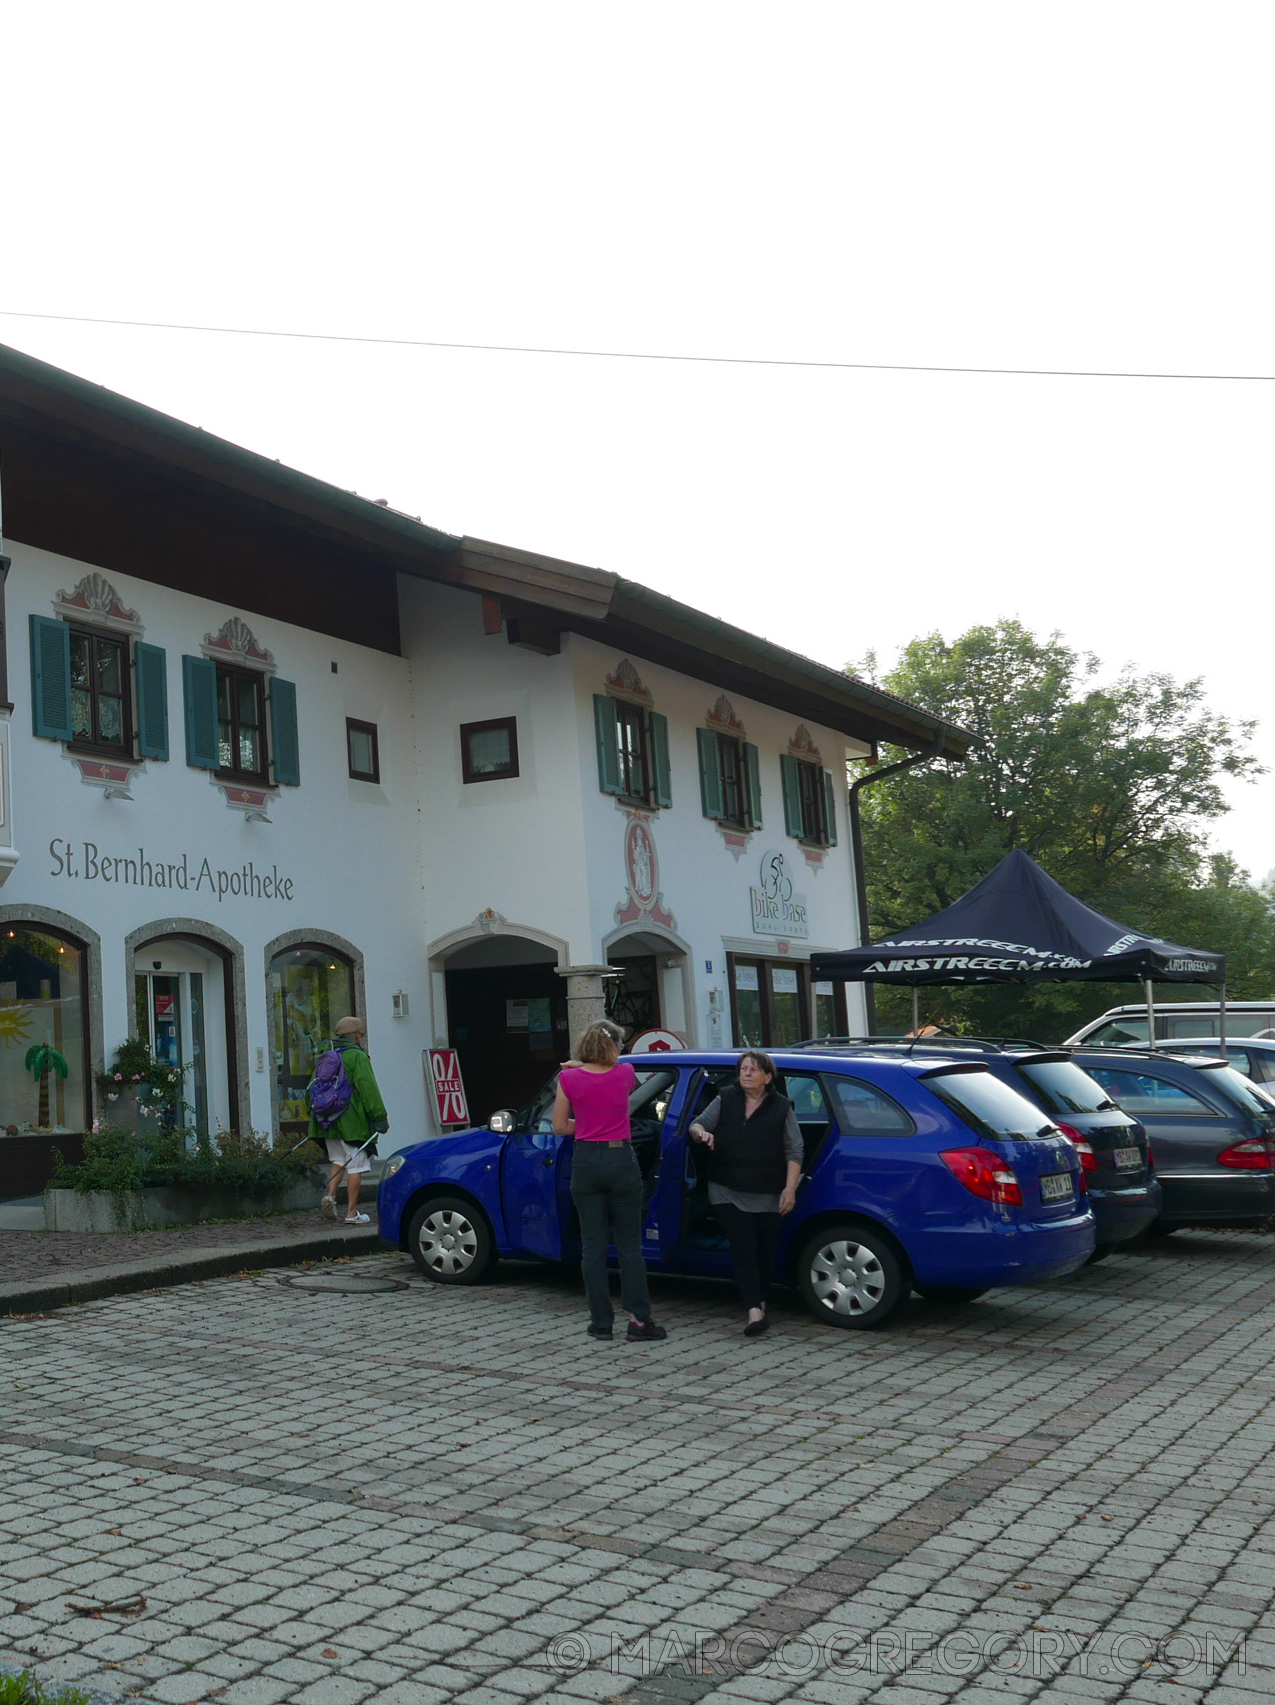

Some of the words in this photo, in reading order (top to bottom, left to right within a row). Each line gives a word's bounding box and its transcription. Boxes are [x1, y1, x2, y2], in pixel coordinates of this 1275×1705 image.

[49, 838, 79, 878] St.
[83, 842, 294, 902] Bernhard-Apotheke
[750, 887, 779, 919] bike
[438, 1081, 460, 1092] SALE
